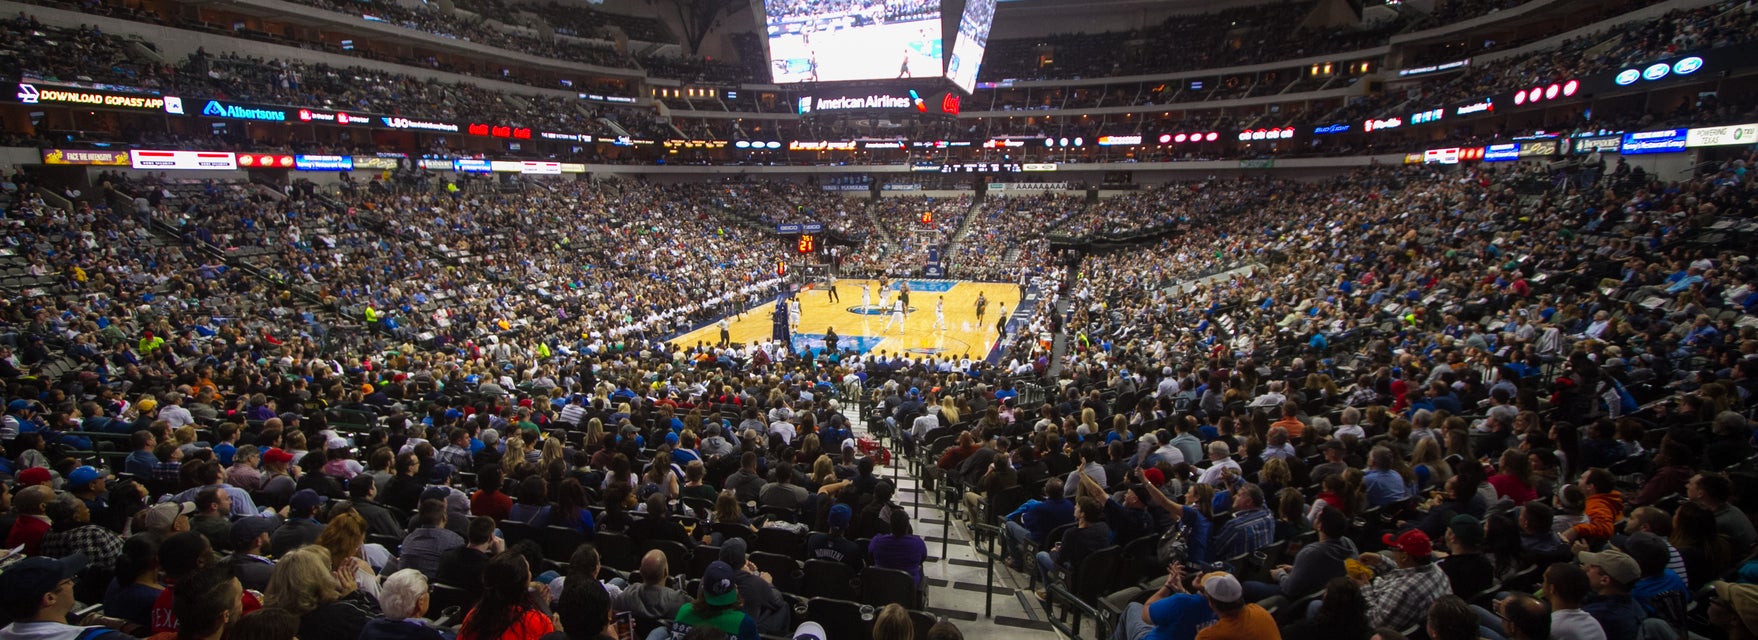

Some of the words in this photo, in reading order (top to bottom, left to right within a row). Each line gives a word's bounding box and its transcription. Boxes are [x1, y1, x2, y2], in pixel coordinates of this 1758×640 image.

[40, 90, 103, 104] DOWNLOAD
[144, 99, 164, 108] APP
[816, 96, 866, 110] American
[866, 94, 910, 108] Airlines
[227, 105, 285, 121] Albertsons
[1696, 128, 1728, 136] POWERING
[1702, 136, 1719, 144] TEXAS
[800, 240, 812, 251] 21
